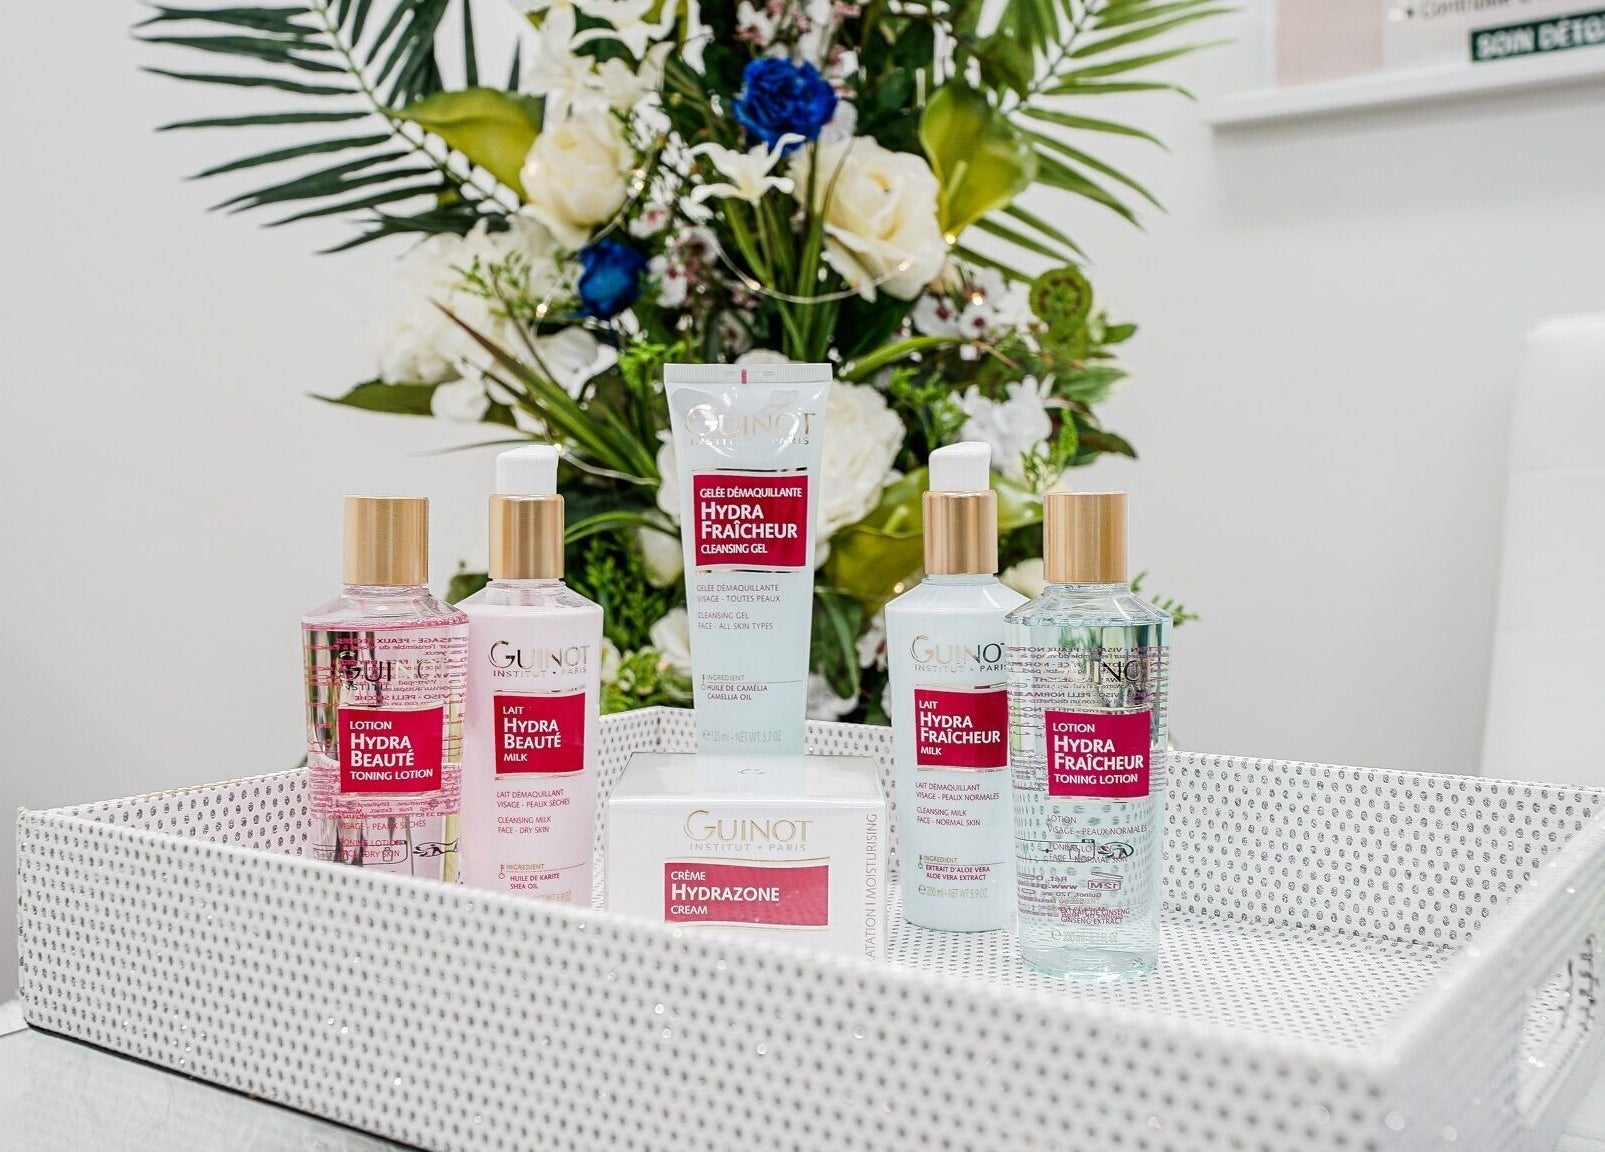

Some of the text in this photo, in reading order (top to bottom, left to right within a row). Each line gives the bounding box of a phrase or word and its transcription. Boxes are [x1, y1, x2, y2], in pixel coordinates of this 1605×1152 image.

[684, 403, 816, 436] GUINOT
[700, 486, 803, 499] GELÉE DÉMAQUILLANTE
[701, 502, 764, 520] HYDRA
[701, 521, 798, 540] FRAÎCHEUR
[701, 544, 768, 554] CLEANSING GEL
[717, 584, 780, 592] DÉMAQUILLANTE
[727, 595, 754, 603] TOUTES
[757, 594, 781, 602] PEAUX
[698, 612, 749, 620] CLEANSING GEL
[752, 623, 774, 631] TYPES
[488, 640, 590, 669] GUINOT
[503, 706, 523, 714] LAIT
[919, 700, 938, 709] LAIT
[350, 721, 392, 730] LOTION
[504, 717, 558, 733] HYDRA
[920, 711, 973, 729] HYDRA
[1053, 723, 1095, 732] LOTION
[504, 732, 561, 749] BEAUTÉ
[920, 727, 1001, 744] FRAÎCHEUR
[351, 733, 411, 750] HYDRA
[1054, 735, 1115, 753] HYDRA
[920, 746, 942, 755] MILK
[351, 749, 414, 767] BEAUTÉ
[503, 753, 527, 762] MILK
[1054, 752, 1144, 771] FRAÎCHEUR
[351, 769, 433, 780] TONING LOTION
[1054, 773, 1138, 784] TONING LOTION
[916, 791, 936, 799] VISAGE
[965, 792, 1000, 800] NORMALES
[916, 806, 949, 816] CLEANSING
[917, 816, 930, 824] FACE
[936, 818, 964, 826] NORMAL
[1047, 815, 1077, 824] LOTION
[683, 809, 813, 843] GUINOT
[1048, 825, 1147, 836] VISAGE PEAUX NORMALES
[690, 843, 806, 852] INSTITUT PARIS
[925, 864, 948, 872] EXTRAIT
[670, 870, 706, 881] CRÈME
[864, 812, 879, 962] ATATION MOISTURISING
[671, 884, 780, 902] HYDRAZONE
[670, 905, 708, 915] CREAM
